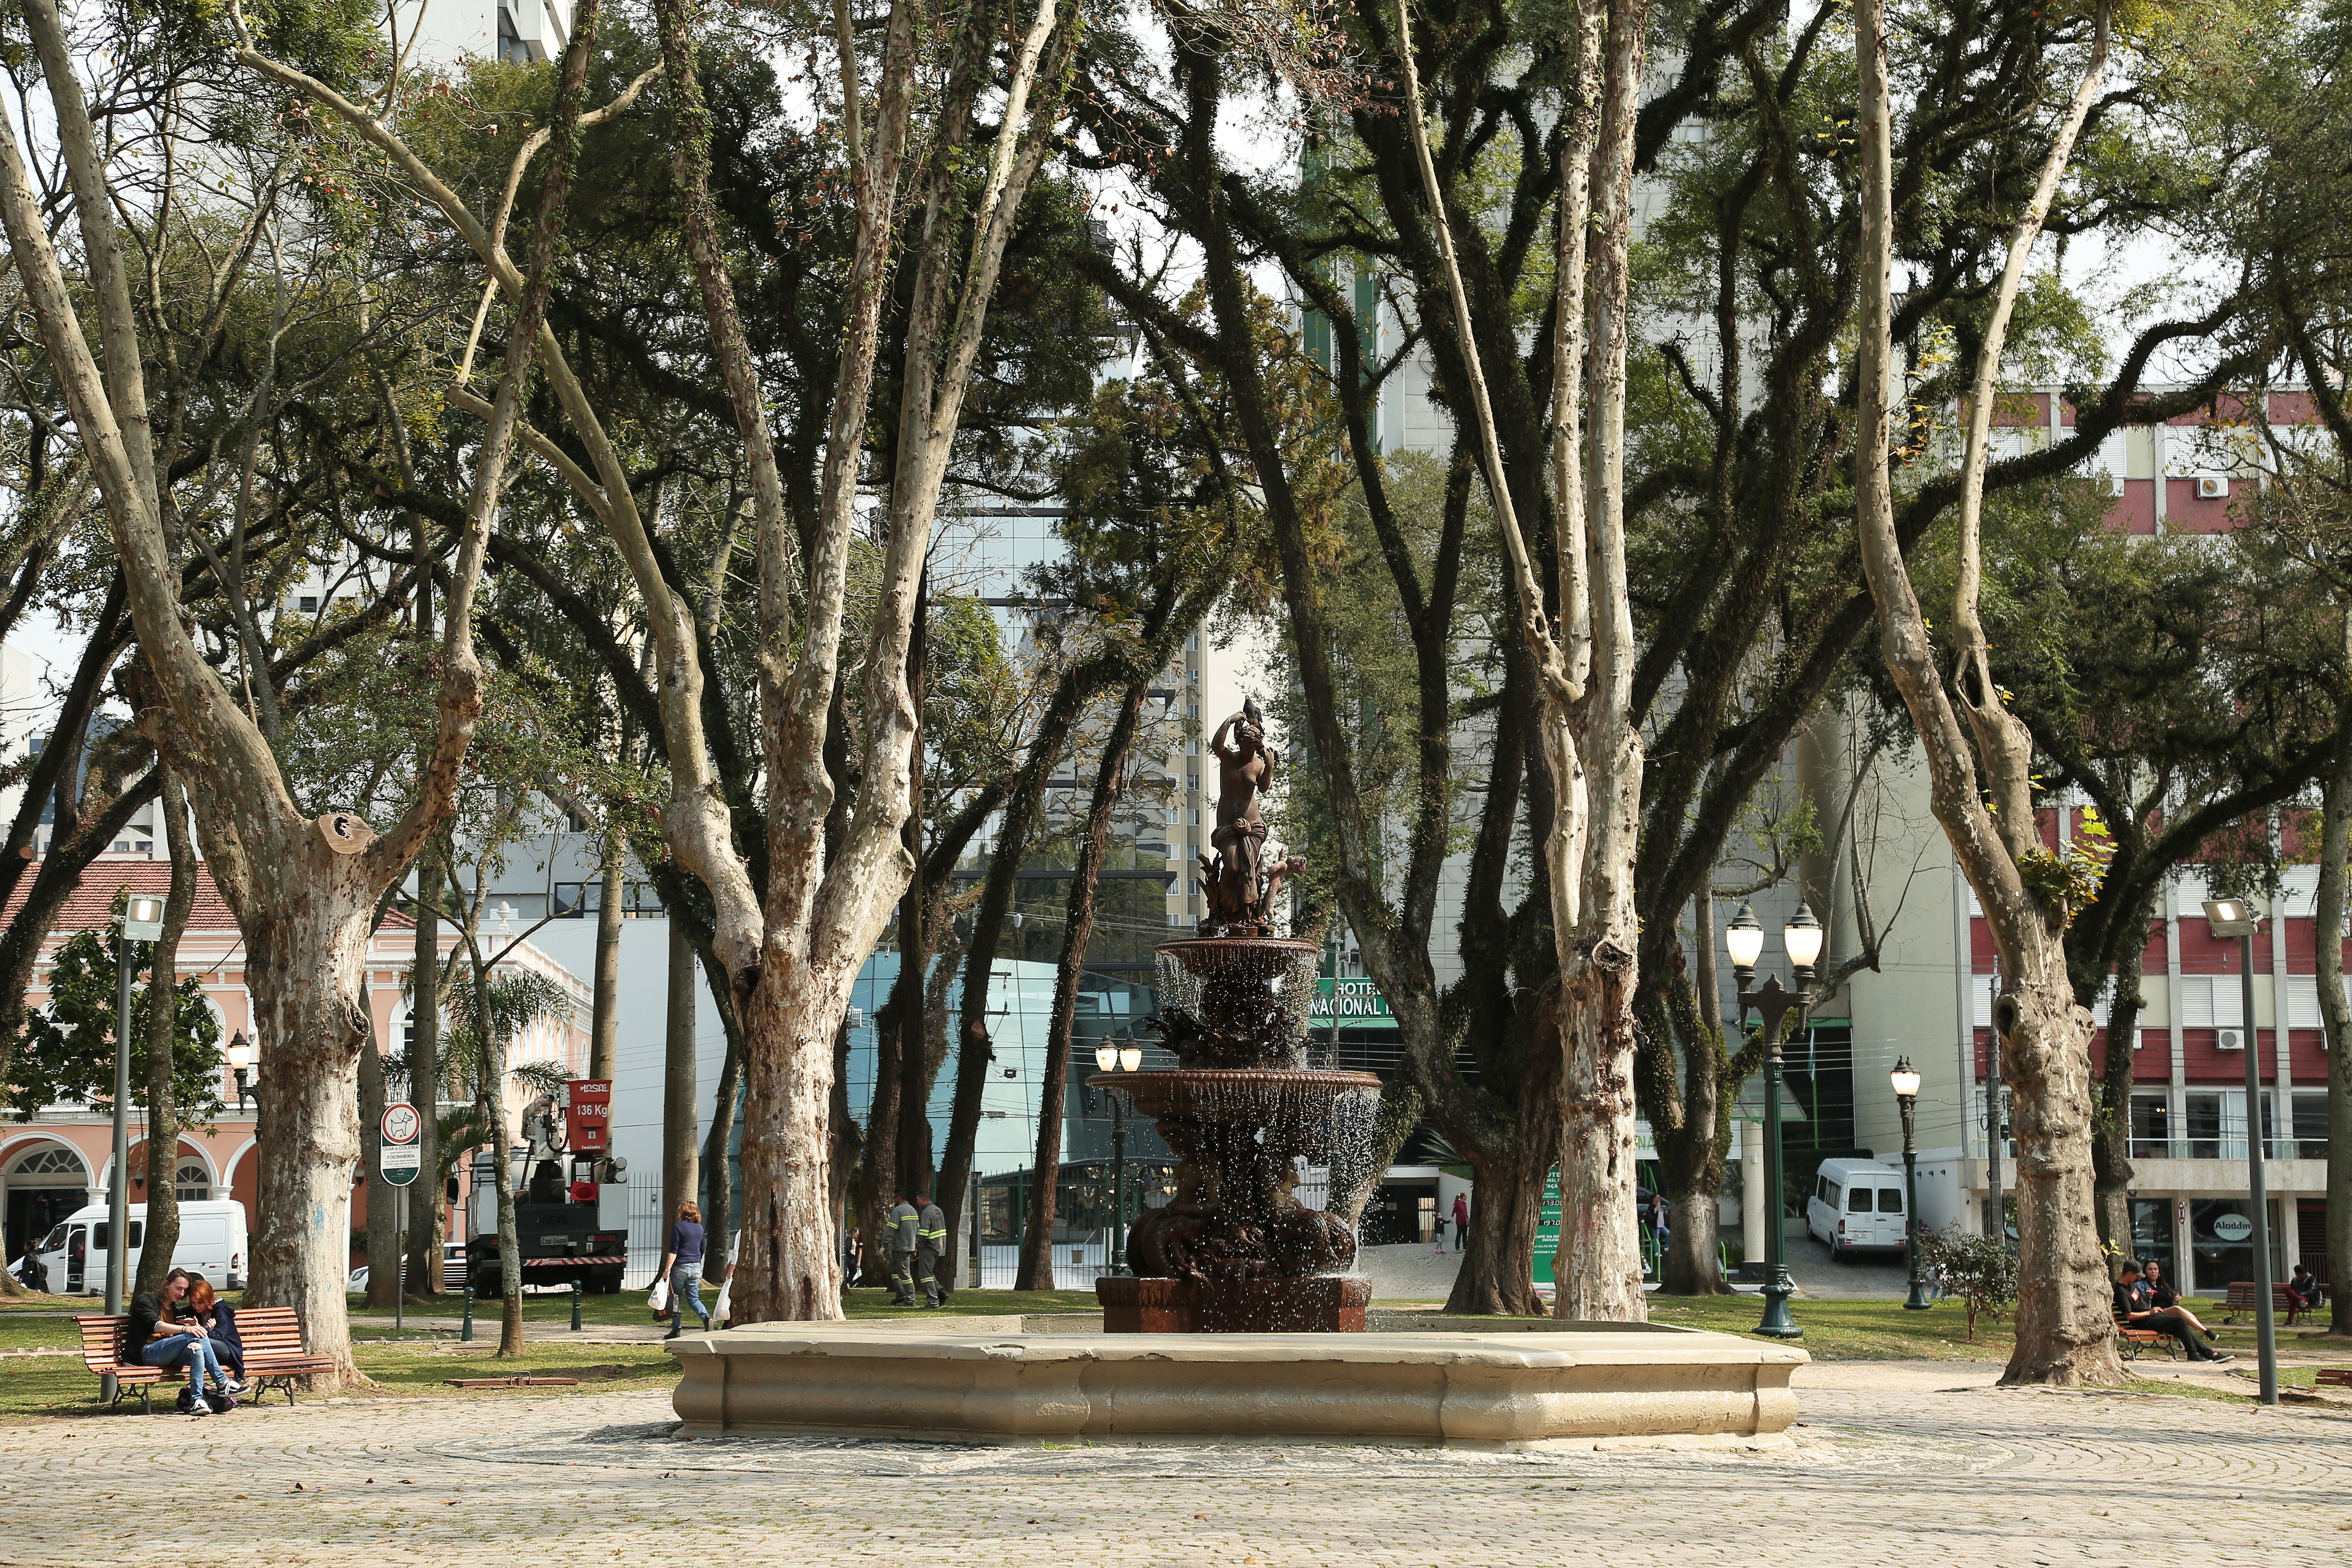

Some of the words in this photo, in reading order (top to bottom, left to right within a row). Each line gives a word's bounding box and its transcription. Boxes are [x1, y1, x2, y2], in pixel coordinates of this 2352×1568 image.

[577, 1105, 592, 1115] 136
[594, 1105, 607, 1118] Kg
[2215, 1221, 2251, 1229] Aladdin
